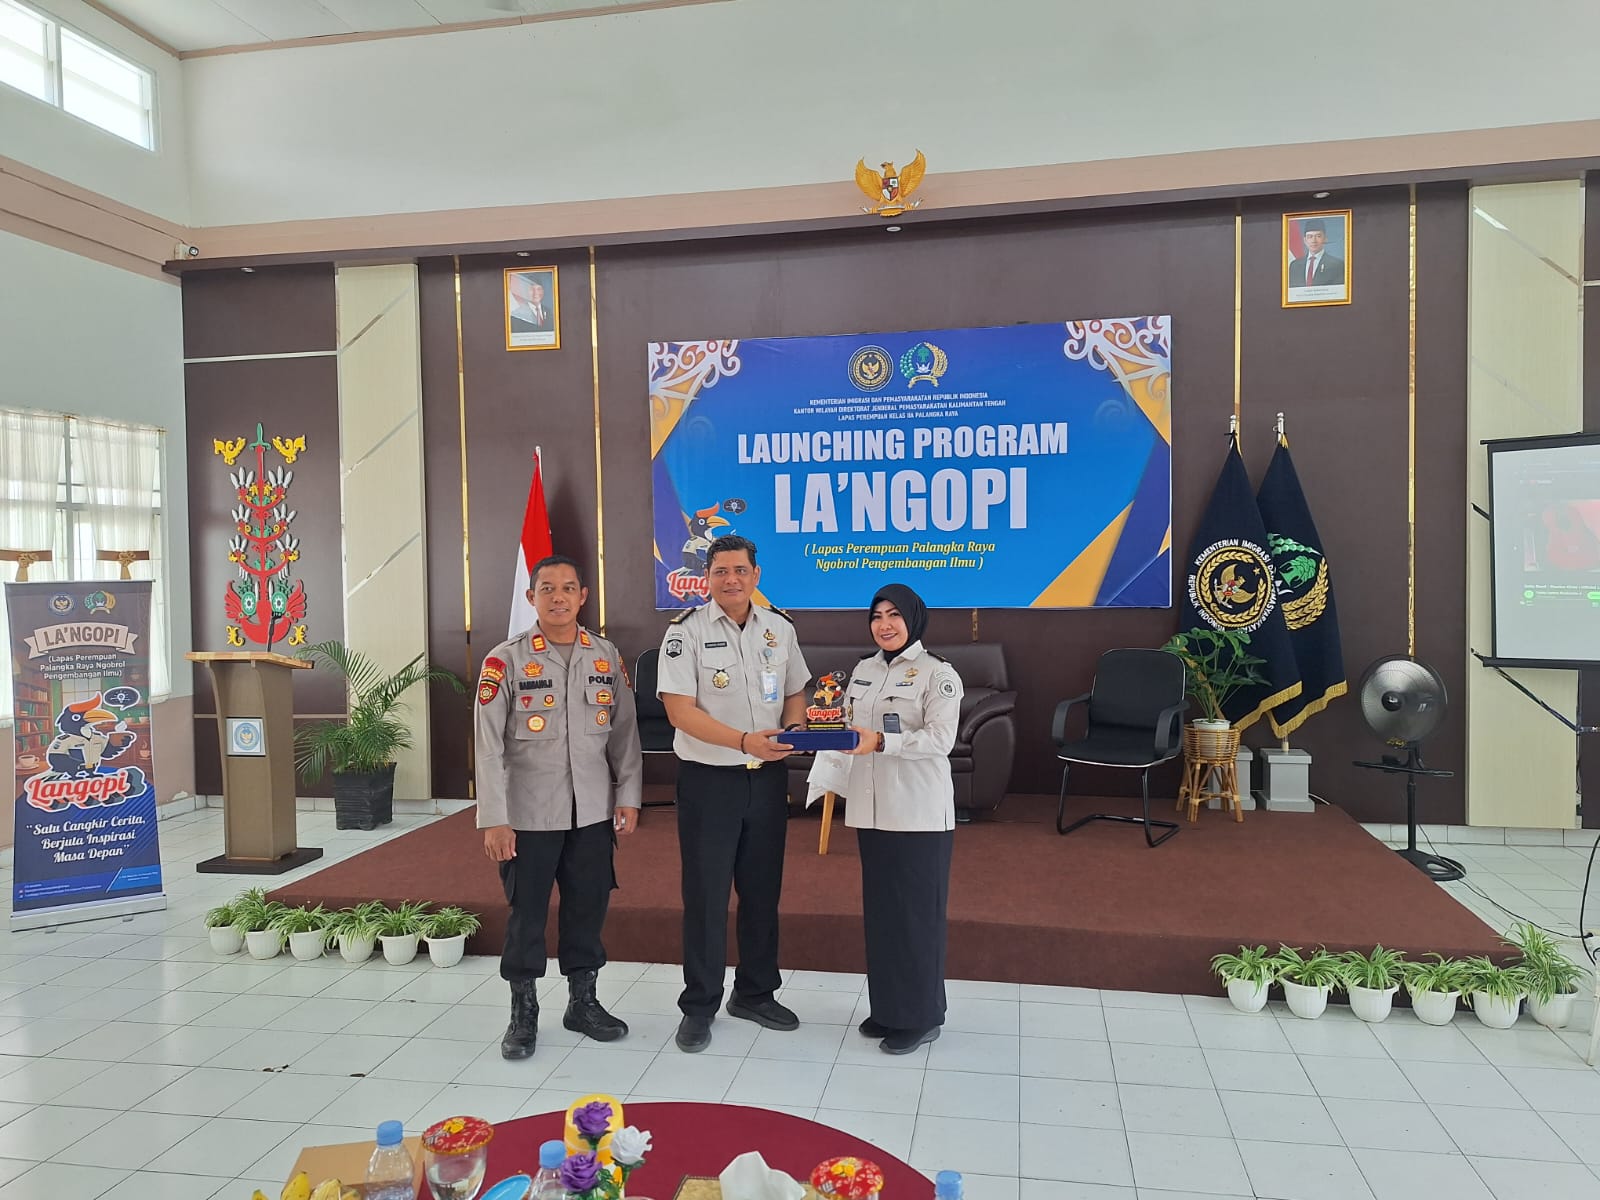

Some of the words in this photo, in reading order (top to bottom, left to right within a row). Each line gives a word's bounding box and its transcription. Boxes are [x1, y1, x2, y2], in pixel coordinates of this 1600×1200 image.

[883, 394, 931, 403] PEMASYARAKATAN
[899, 402, 948, 410] PEMASYARAKATAN
[738, 428, 905, 465] LAUNCHING
[912, 423, 1068, 459] PROGRAM
[774, 467, 1028, 534] LA'NGOPI
[811, 544, 843, 556] Lapas
[844, 542, 909, 556] Perempuan
[912, 541, 965, 555] Palangka
[967, 540, 996, 554] Raya
[1194, 538, 1240, 567] KEMENTERIAN
[1242, 539, 1272, 565] IMIGRASI
[815, 557, 859, 571] Ngobrol
[861, 556, 947, 571] Pengembangan
[949, 556, 977, 568] Ilmu
[666, 572, 710, 596] Lang
[1188, 574, 1202, 609] REPUBLIK
[43, 626, 120, 647] LA'NGOPI
[40, 663, 74, 672] Palangka
[96, 660, 126, 670] Ngobrol
[48, 655, 74, 663] (Lapas
[75, 653, 117, 662] Perempuan
[43, 671, 102, 681] Pengembangan
[103, 670, 122, 678] Ilmu)
[588, 675, 613, 685] POLRI
[808, 706, 841, 720] Langopi
[27, 772, 130, 805] Langopi
[62, 818, 108, 833] Cangkir
[110, 814, 145, 825] Cerita,
[41, 836, 83, 851] Berjuta
[86, 829, 136, 846] Inspirasi
[53, 851, 86, 864] Masa
